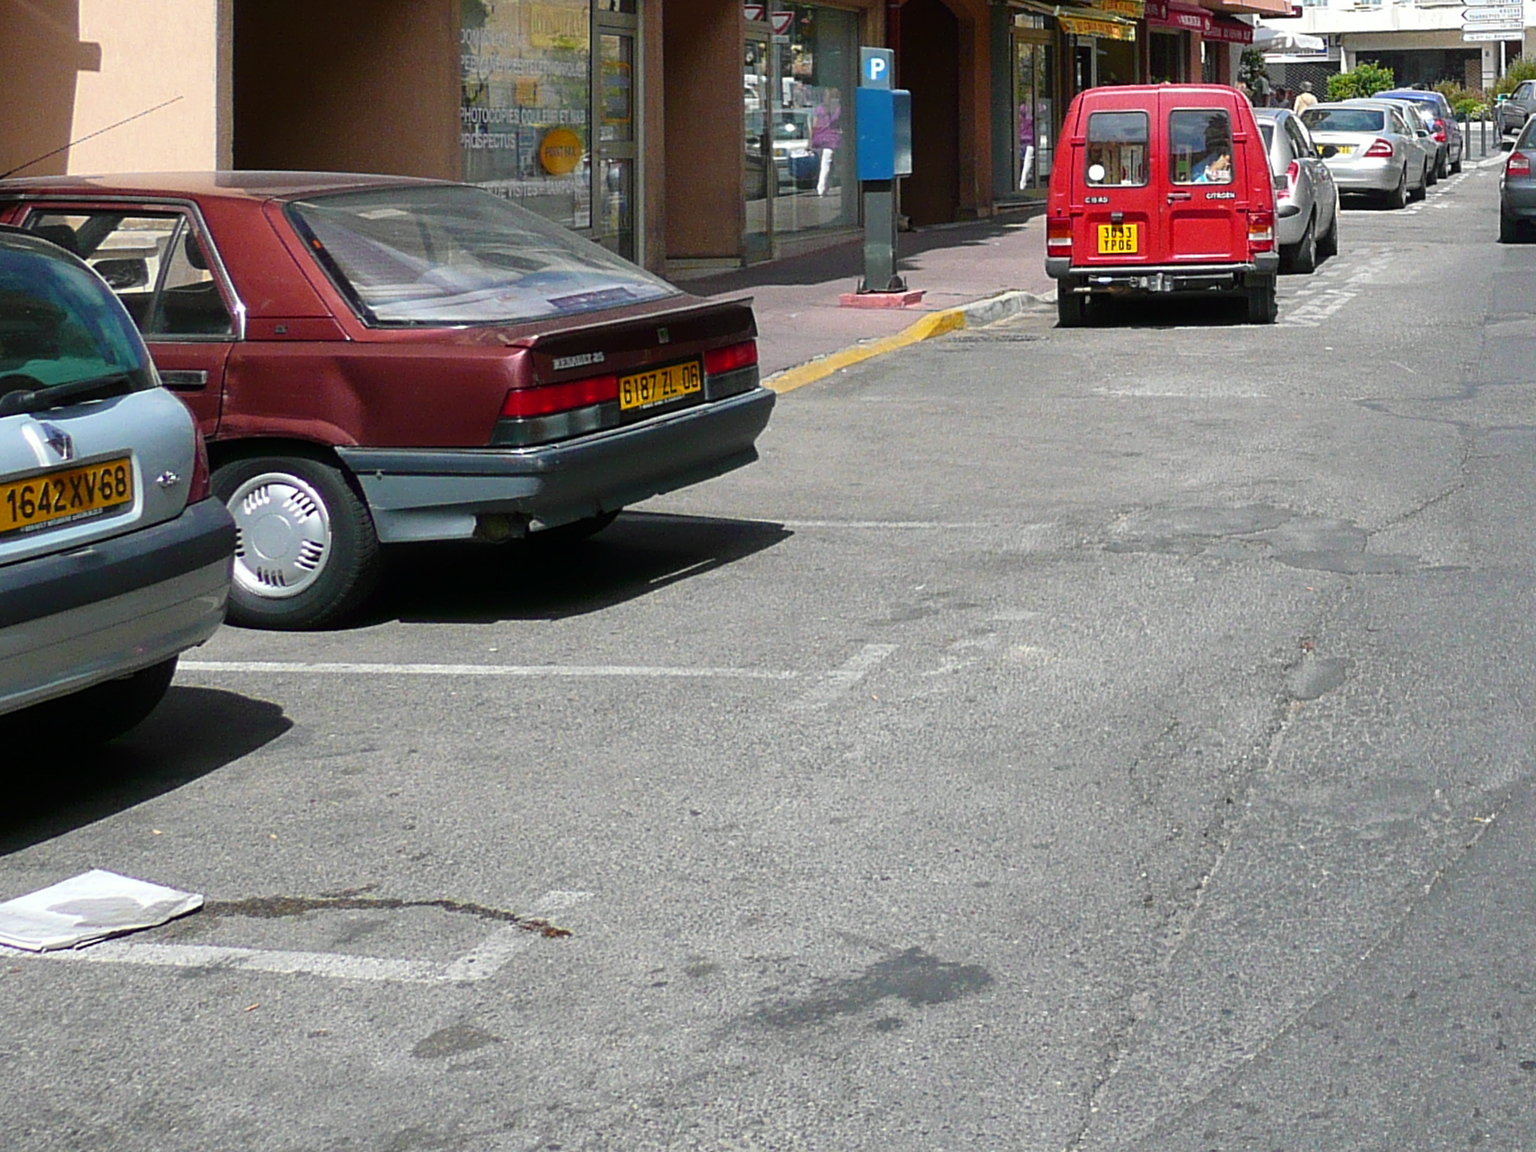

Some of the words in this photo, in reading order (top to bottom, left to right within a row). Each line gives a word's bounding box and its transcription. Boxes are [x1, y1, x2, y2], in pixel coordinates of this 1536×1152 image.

[871, 58, 885, 80] P
[1103, 227, 1132, 239] 3093
[1103, 239, 1132, 251] YP06
[623, 374, 656, 405] 6187
[661, 370, 678, 396] ZL
[682, 364, 699, 390] 06
